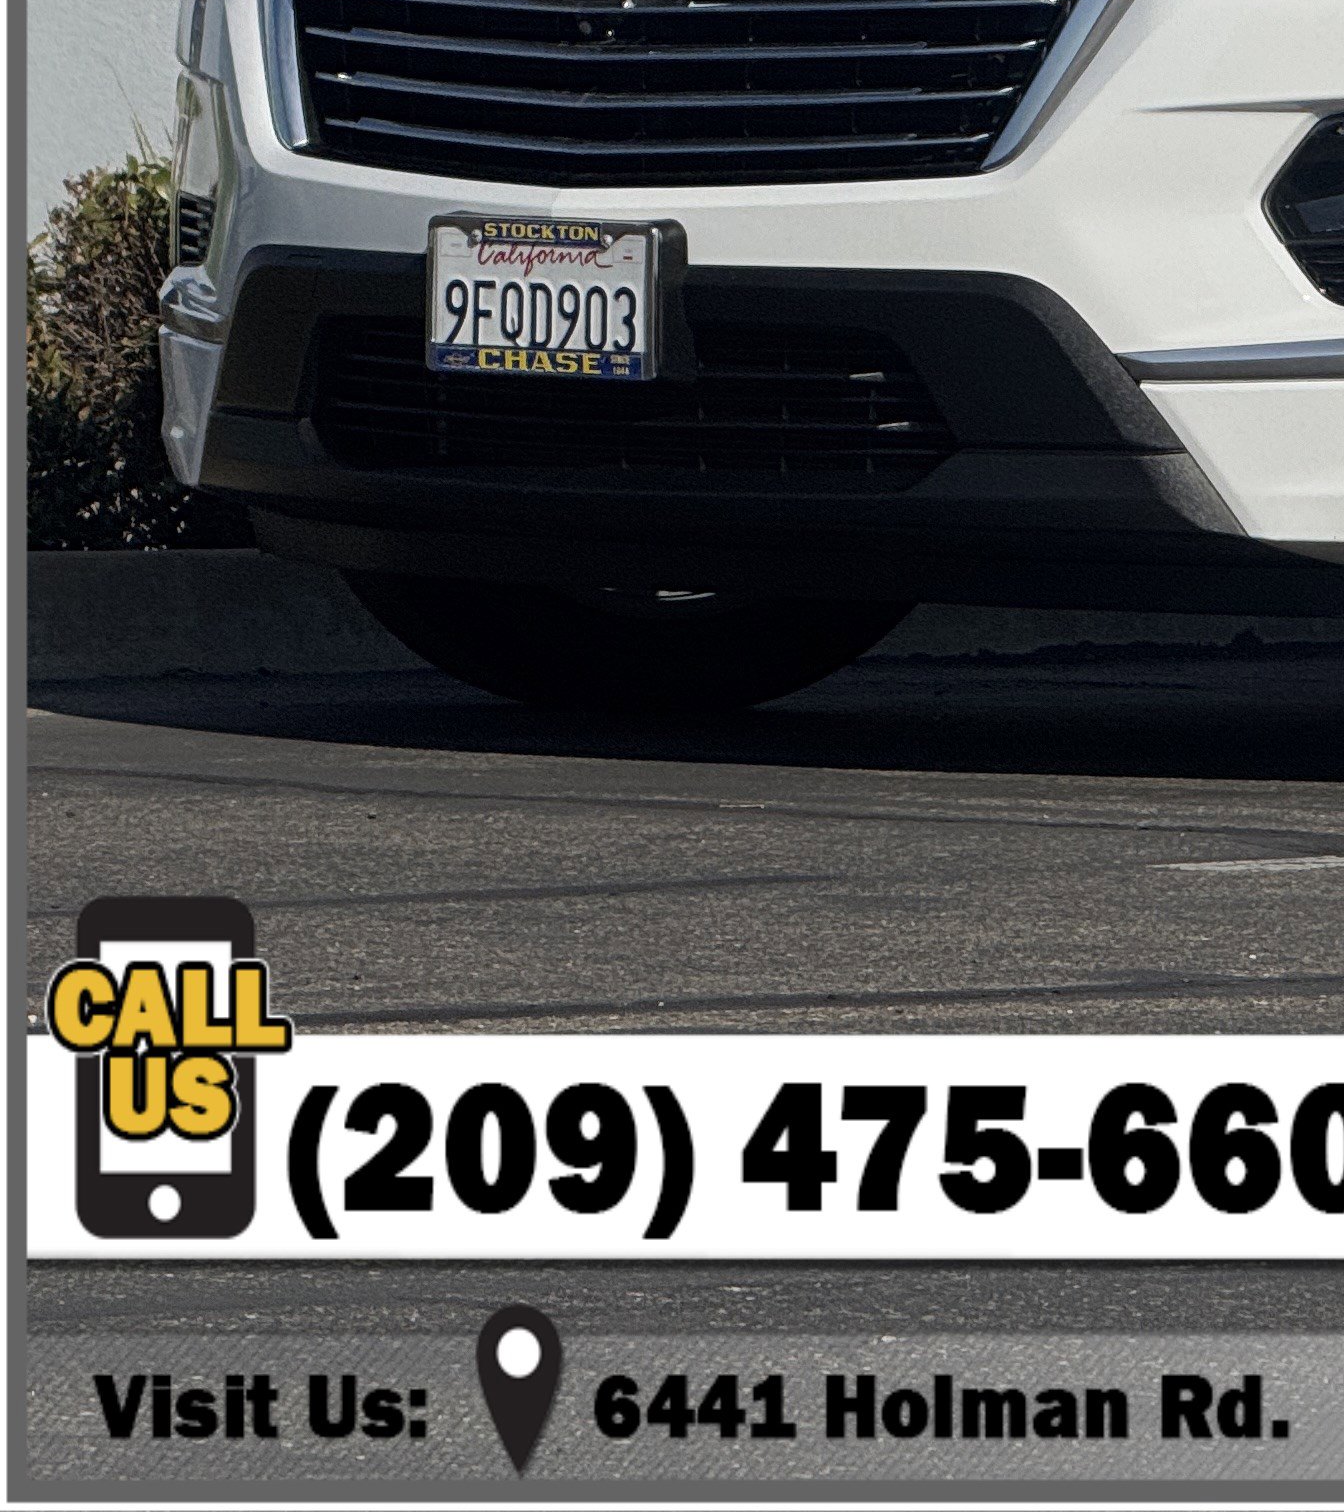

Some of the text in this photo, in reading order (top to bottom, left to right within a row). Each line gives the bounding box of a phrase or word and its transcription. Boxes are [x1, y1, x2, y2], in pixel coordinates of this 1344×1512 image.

[483, 222, 600, 241] STOCKTON
[477, 242, 613, 277] California
[445, 279, 637, 351] 9FQD903
[478, 348, 602, 376] CHASE
